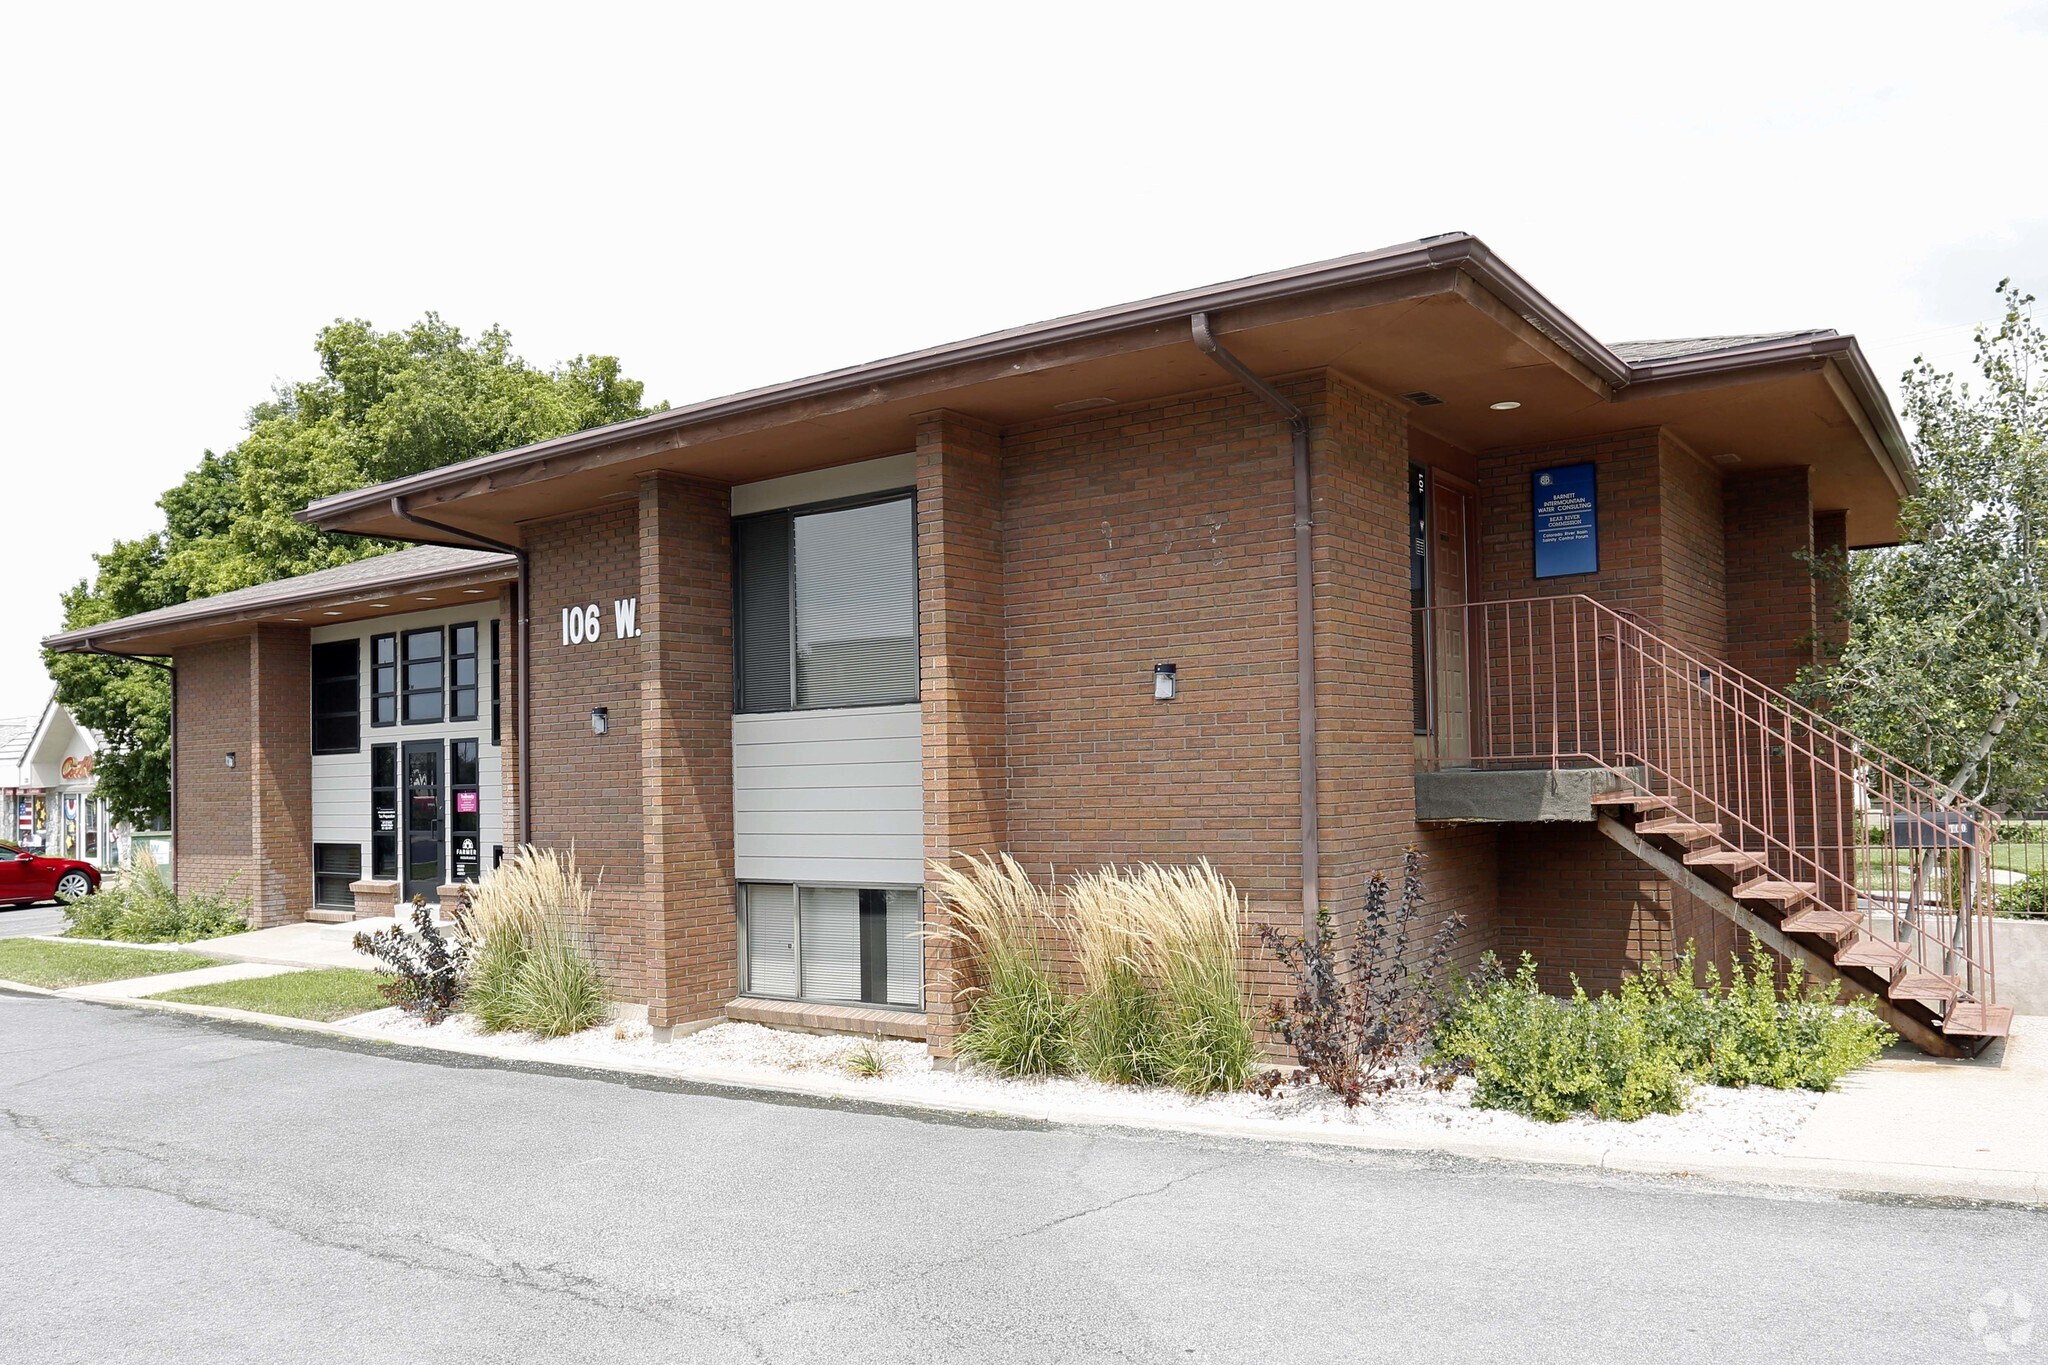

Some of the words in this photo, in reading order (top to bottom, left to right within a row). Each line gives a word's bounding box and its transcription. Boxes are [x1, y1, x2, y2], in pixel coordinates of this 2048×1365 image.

[1544, 498, 1585, 507] INTERMOUNTAIN
[1557, 503, 1591, 511] CONSULTING
[1548, 520, 1582, 528] COMMISSION
[562, 604, 600, 646] 106
[614, 598, 641, 639] W.
